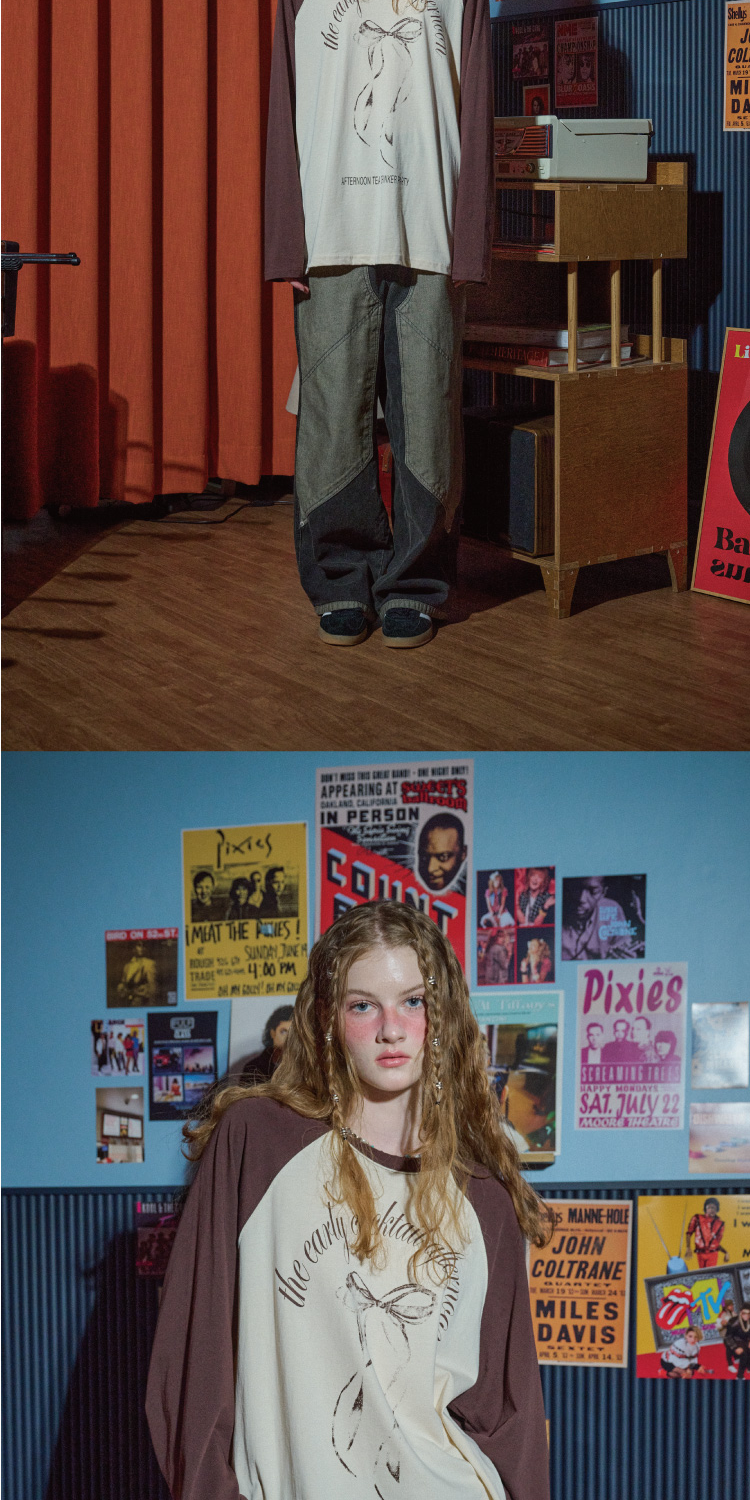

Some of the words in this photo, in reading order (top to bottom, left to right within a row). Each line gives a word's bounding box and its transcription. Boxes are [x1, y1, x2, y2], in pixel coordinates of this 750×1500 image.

[320, 22, 340, 51] the
[417, 767, 429, 778] ONE
[431, 766, 449, 777] NIGHT
[320, 782, 382, 799] APPEARING
[385, 781, 398, 795] AT
[320, 811, 338, 825] IN
[347, 807, 420, 823] PERSON
[216, 828, 273, 870] Pixies
[327, 847, 459, 937] COUNT
[130, 930, 143, 940] ON
[226, 920, 249, 942] THE
[248, 961, 276, 979] 4:00
[280, 961, 297, 976] PM
[583, 967, 683, 1015] Pixies
[581, 1065, 643, 1082] SCREAMING
[580, 1085, 611, 1093] HAPPY
[615, 1084, 659, 1093] MONDAYS
[579, 1093, 613, 1115] SAT.
[617, 1093, 660, 1119] JULY
[662, 1093, 680, 1115] 22
[580, 1117, 626, 1128] MOORE
[627, 1116, 680, 1128] THEATRE
[568, 1207, 630, 1224] MANNE-HOLE
[274, 1259, 311, 1308] the
[303, 1201, 351, 1264] early
[551, 1235, 606, 1256] JOHN
[531, 1259, 626, 1281] COLTRANE
[556, 1287, 566, 1295] 19
[535, 1299, 619, 1321] MILES
[537, 1323, 616, 1345] DAVIS
